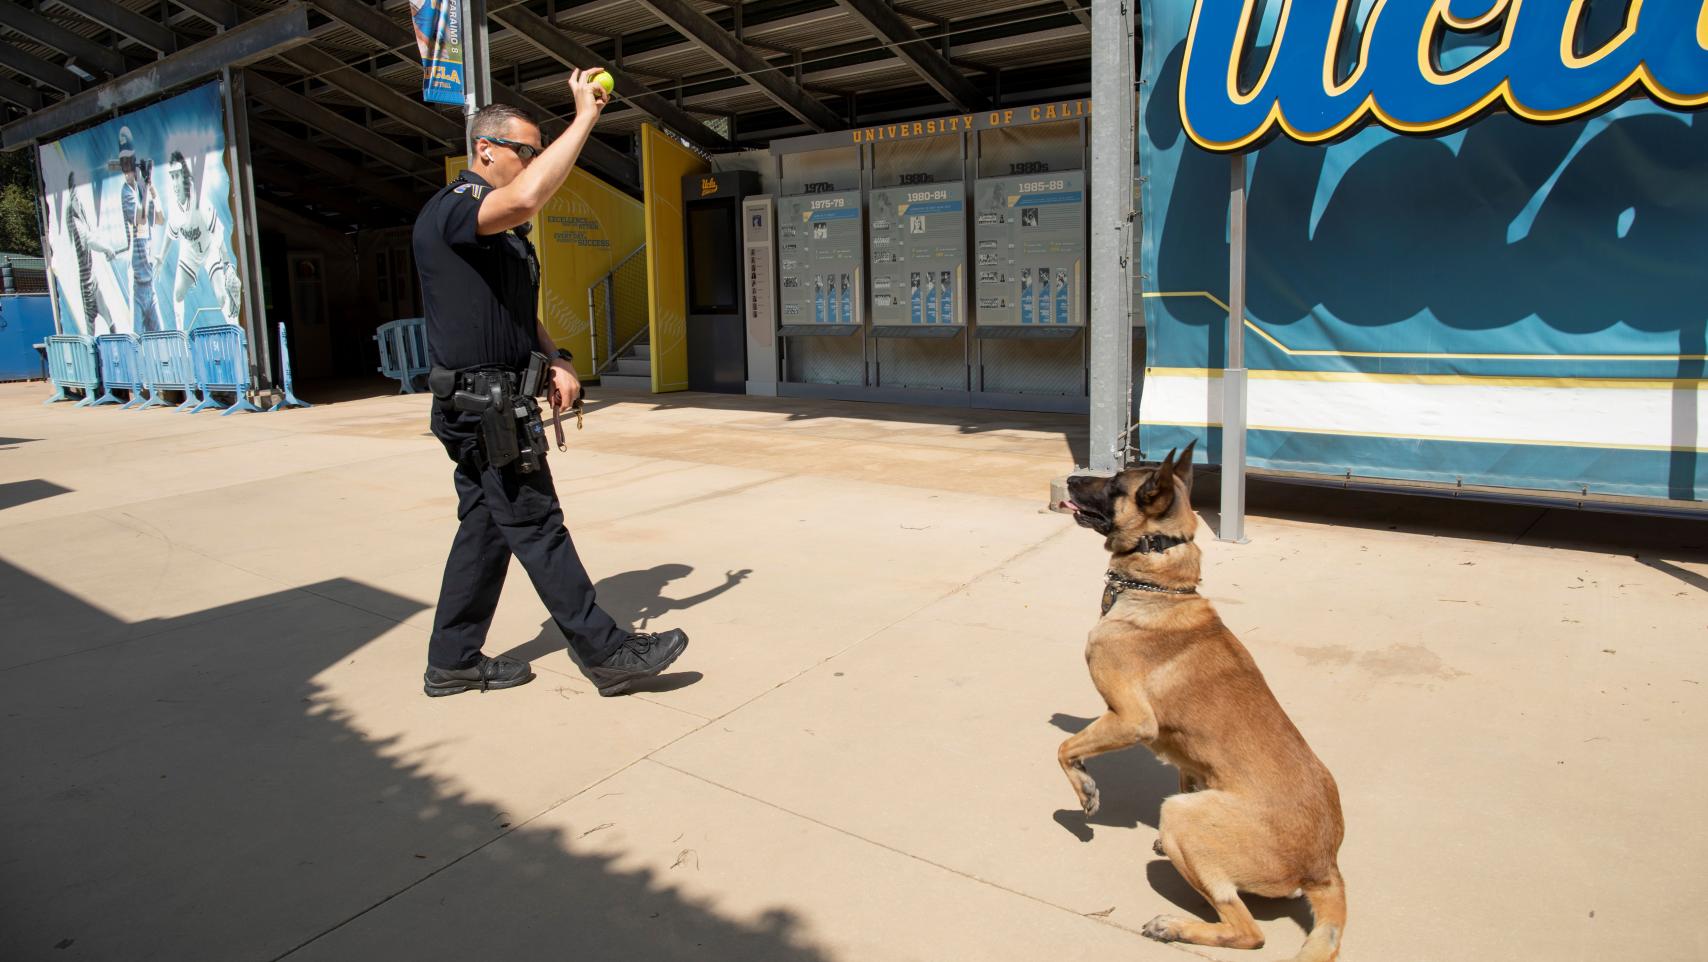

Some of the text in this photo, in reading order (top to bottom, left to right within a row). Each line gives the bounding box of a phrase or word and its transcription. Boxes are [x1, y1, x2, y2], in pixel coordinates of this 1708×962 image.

[424, 66, 461, 84] UCLA
[853, 116, 973, 143] UNIVERSITY
[990, 110, 1013, 125] OF
[1009, 161, 1049, 175] 1980s
[899, 172, 934, 185] 1980s
[804, 182, 834, 194] 1970s
[908, 190, 947, 202] 1980-84
